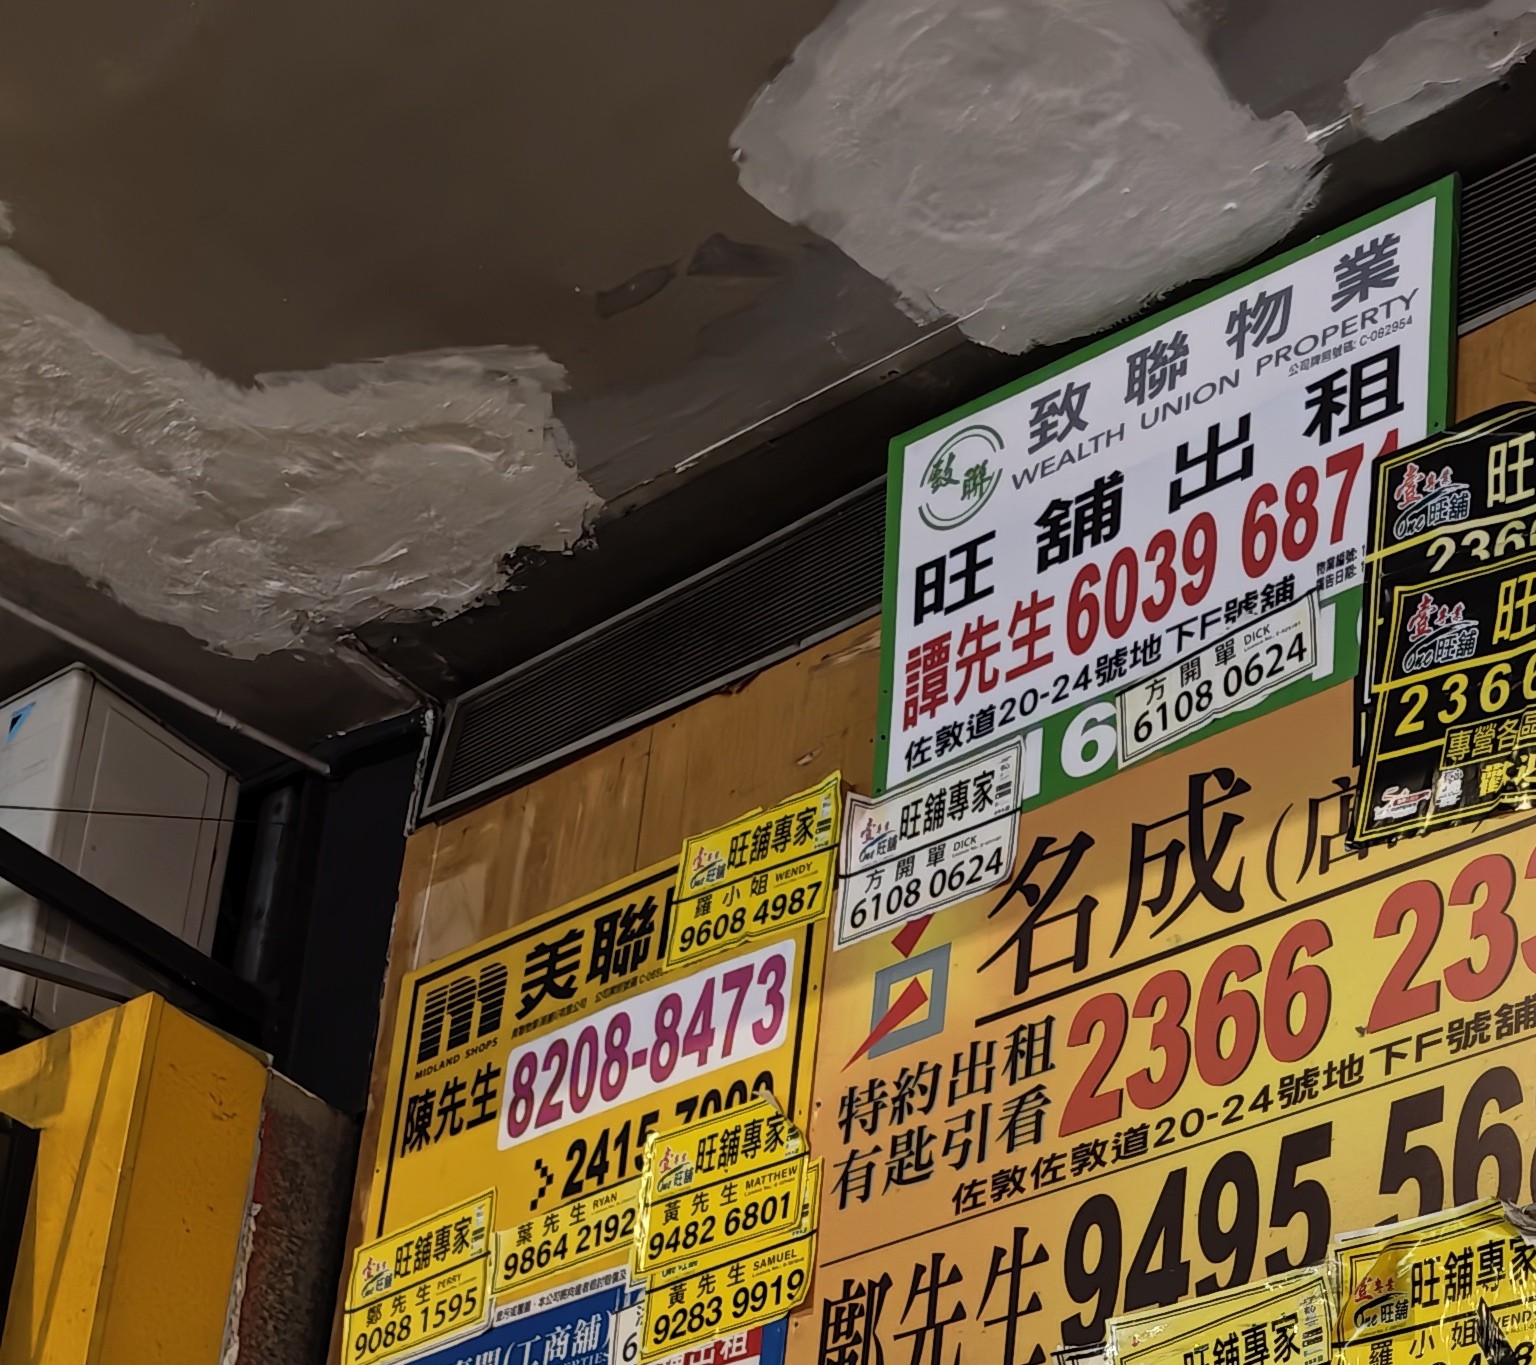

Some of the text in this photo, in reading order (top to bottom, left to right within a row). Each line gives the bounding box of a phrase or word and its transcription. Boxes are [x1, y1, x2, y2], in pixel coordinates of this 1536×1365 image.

[1012, 287, 1420, 490] WEALTH UNION PROPERTY
[1028, 234, 1401, 456] 致聯物業
[913, 346, 1404, 626] 旺舖出租
[903, 591, 1055, 732] 譚先生
[1066, 512, 1218, 655] 6039
[1242, 623, 1271, 645] DICK
[1133, 633, 1308, 743] 6108 0624
[729, 806, 815, 869] 旺舖專家
[775, 862, 814, 882] WENDY
[976, 767, 1248, 999] 名成
[679, 880, 822, 952] 9608 4987
[414, 1038, 499, 1080] MIDLAND SHOPS
[506, 952, 788, 1140] 8208-8473
[837, 1014, 1057, 1143] 特約出租
[1061, 918, 1332, 1139] 2366
[592, 1192, 618, 1209] RYAN
[745, 1165, 799, 1190] MATTHEW
[834, 1086, 1048, 1209] 有匙引看
[650, 1190, 791, 1260] 9482 6801
[1063, 1123, 1334, 1350] 9495
